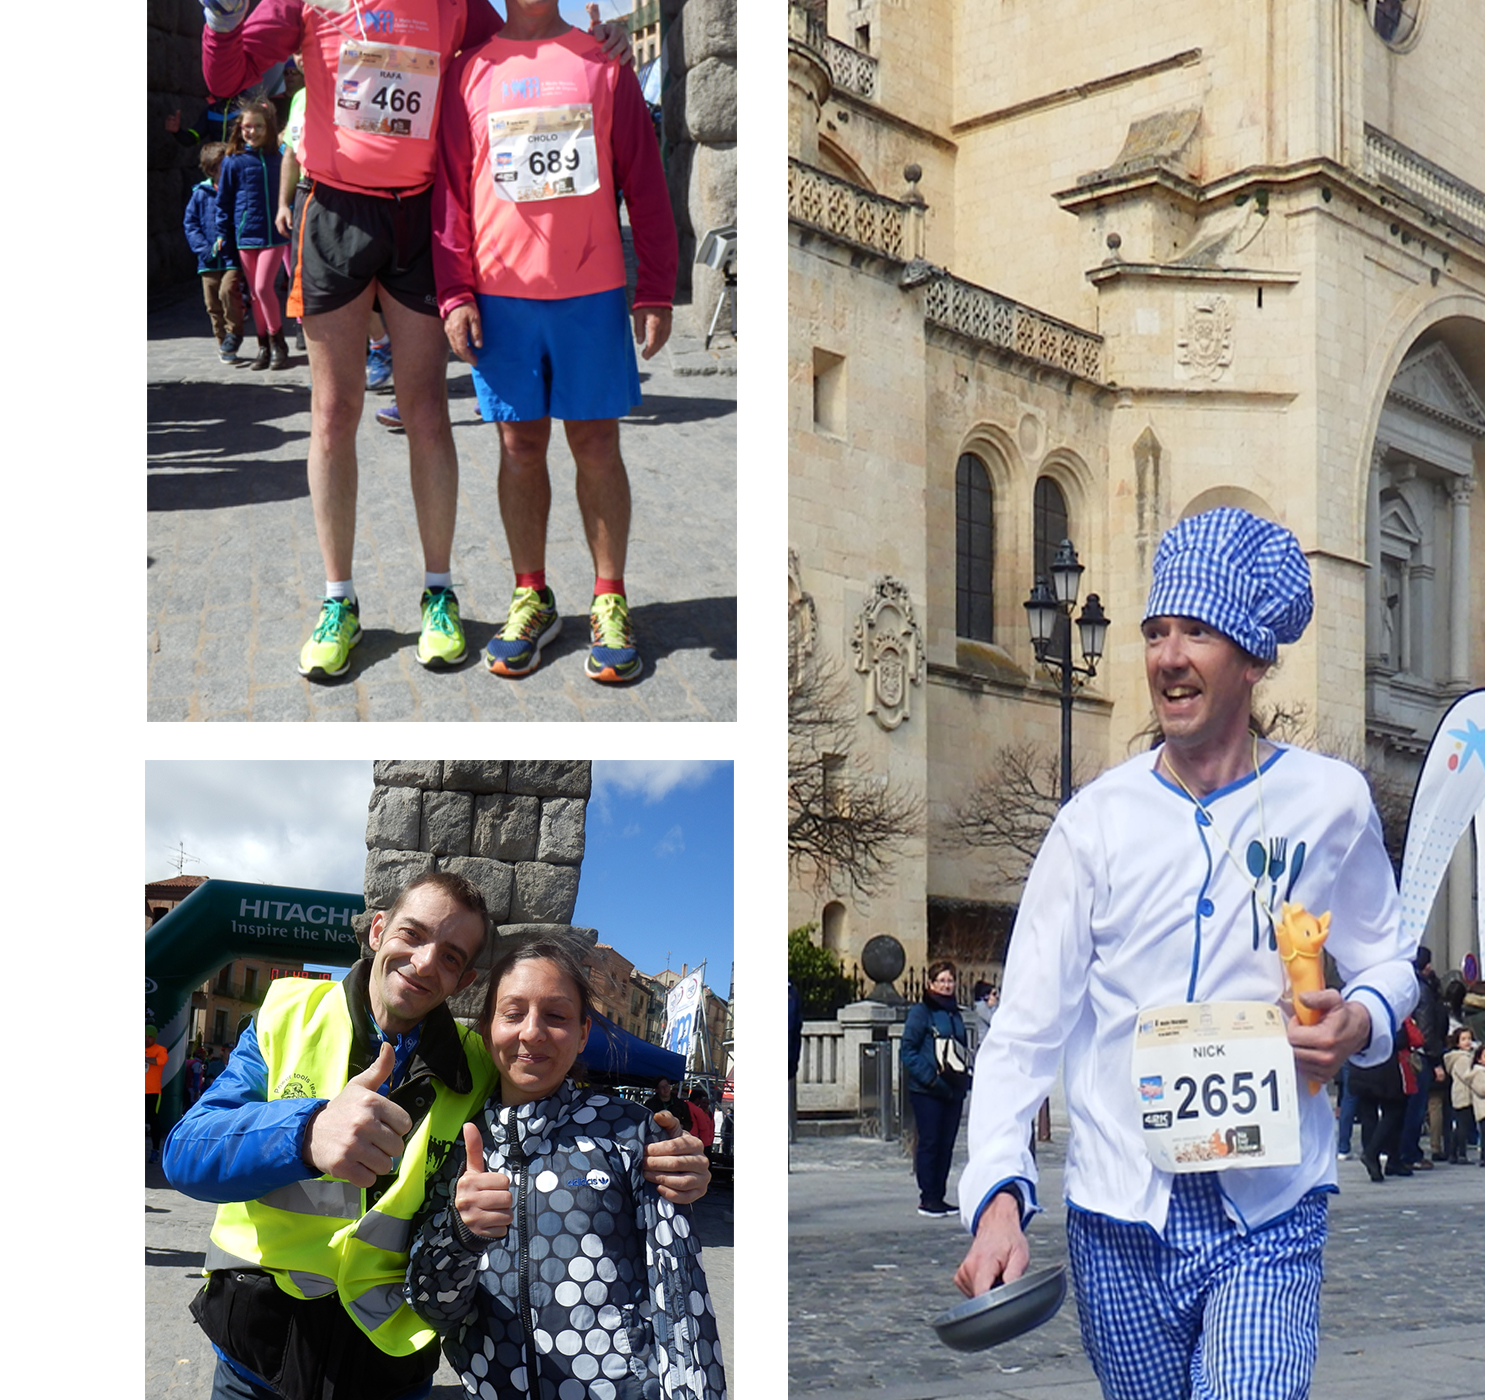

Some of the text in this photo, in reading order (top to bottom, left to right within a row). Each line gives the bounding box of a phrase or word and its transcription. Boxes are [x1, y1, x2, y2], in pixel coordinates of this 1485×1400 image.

[371, 86, 422, 115] 466
[528, 133, 558, 143] CHOLO
[529, 148, 580, 176] 689
[231, 919, 358, 944] Inspire the Nex
[1193, 1044, 1226, 1058] NICK
[293, 1072, 311, 1084] tools
[1174, 1069, 1280, 1120] 2651
[567, 1178, 598, 1187] adidas
